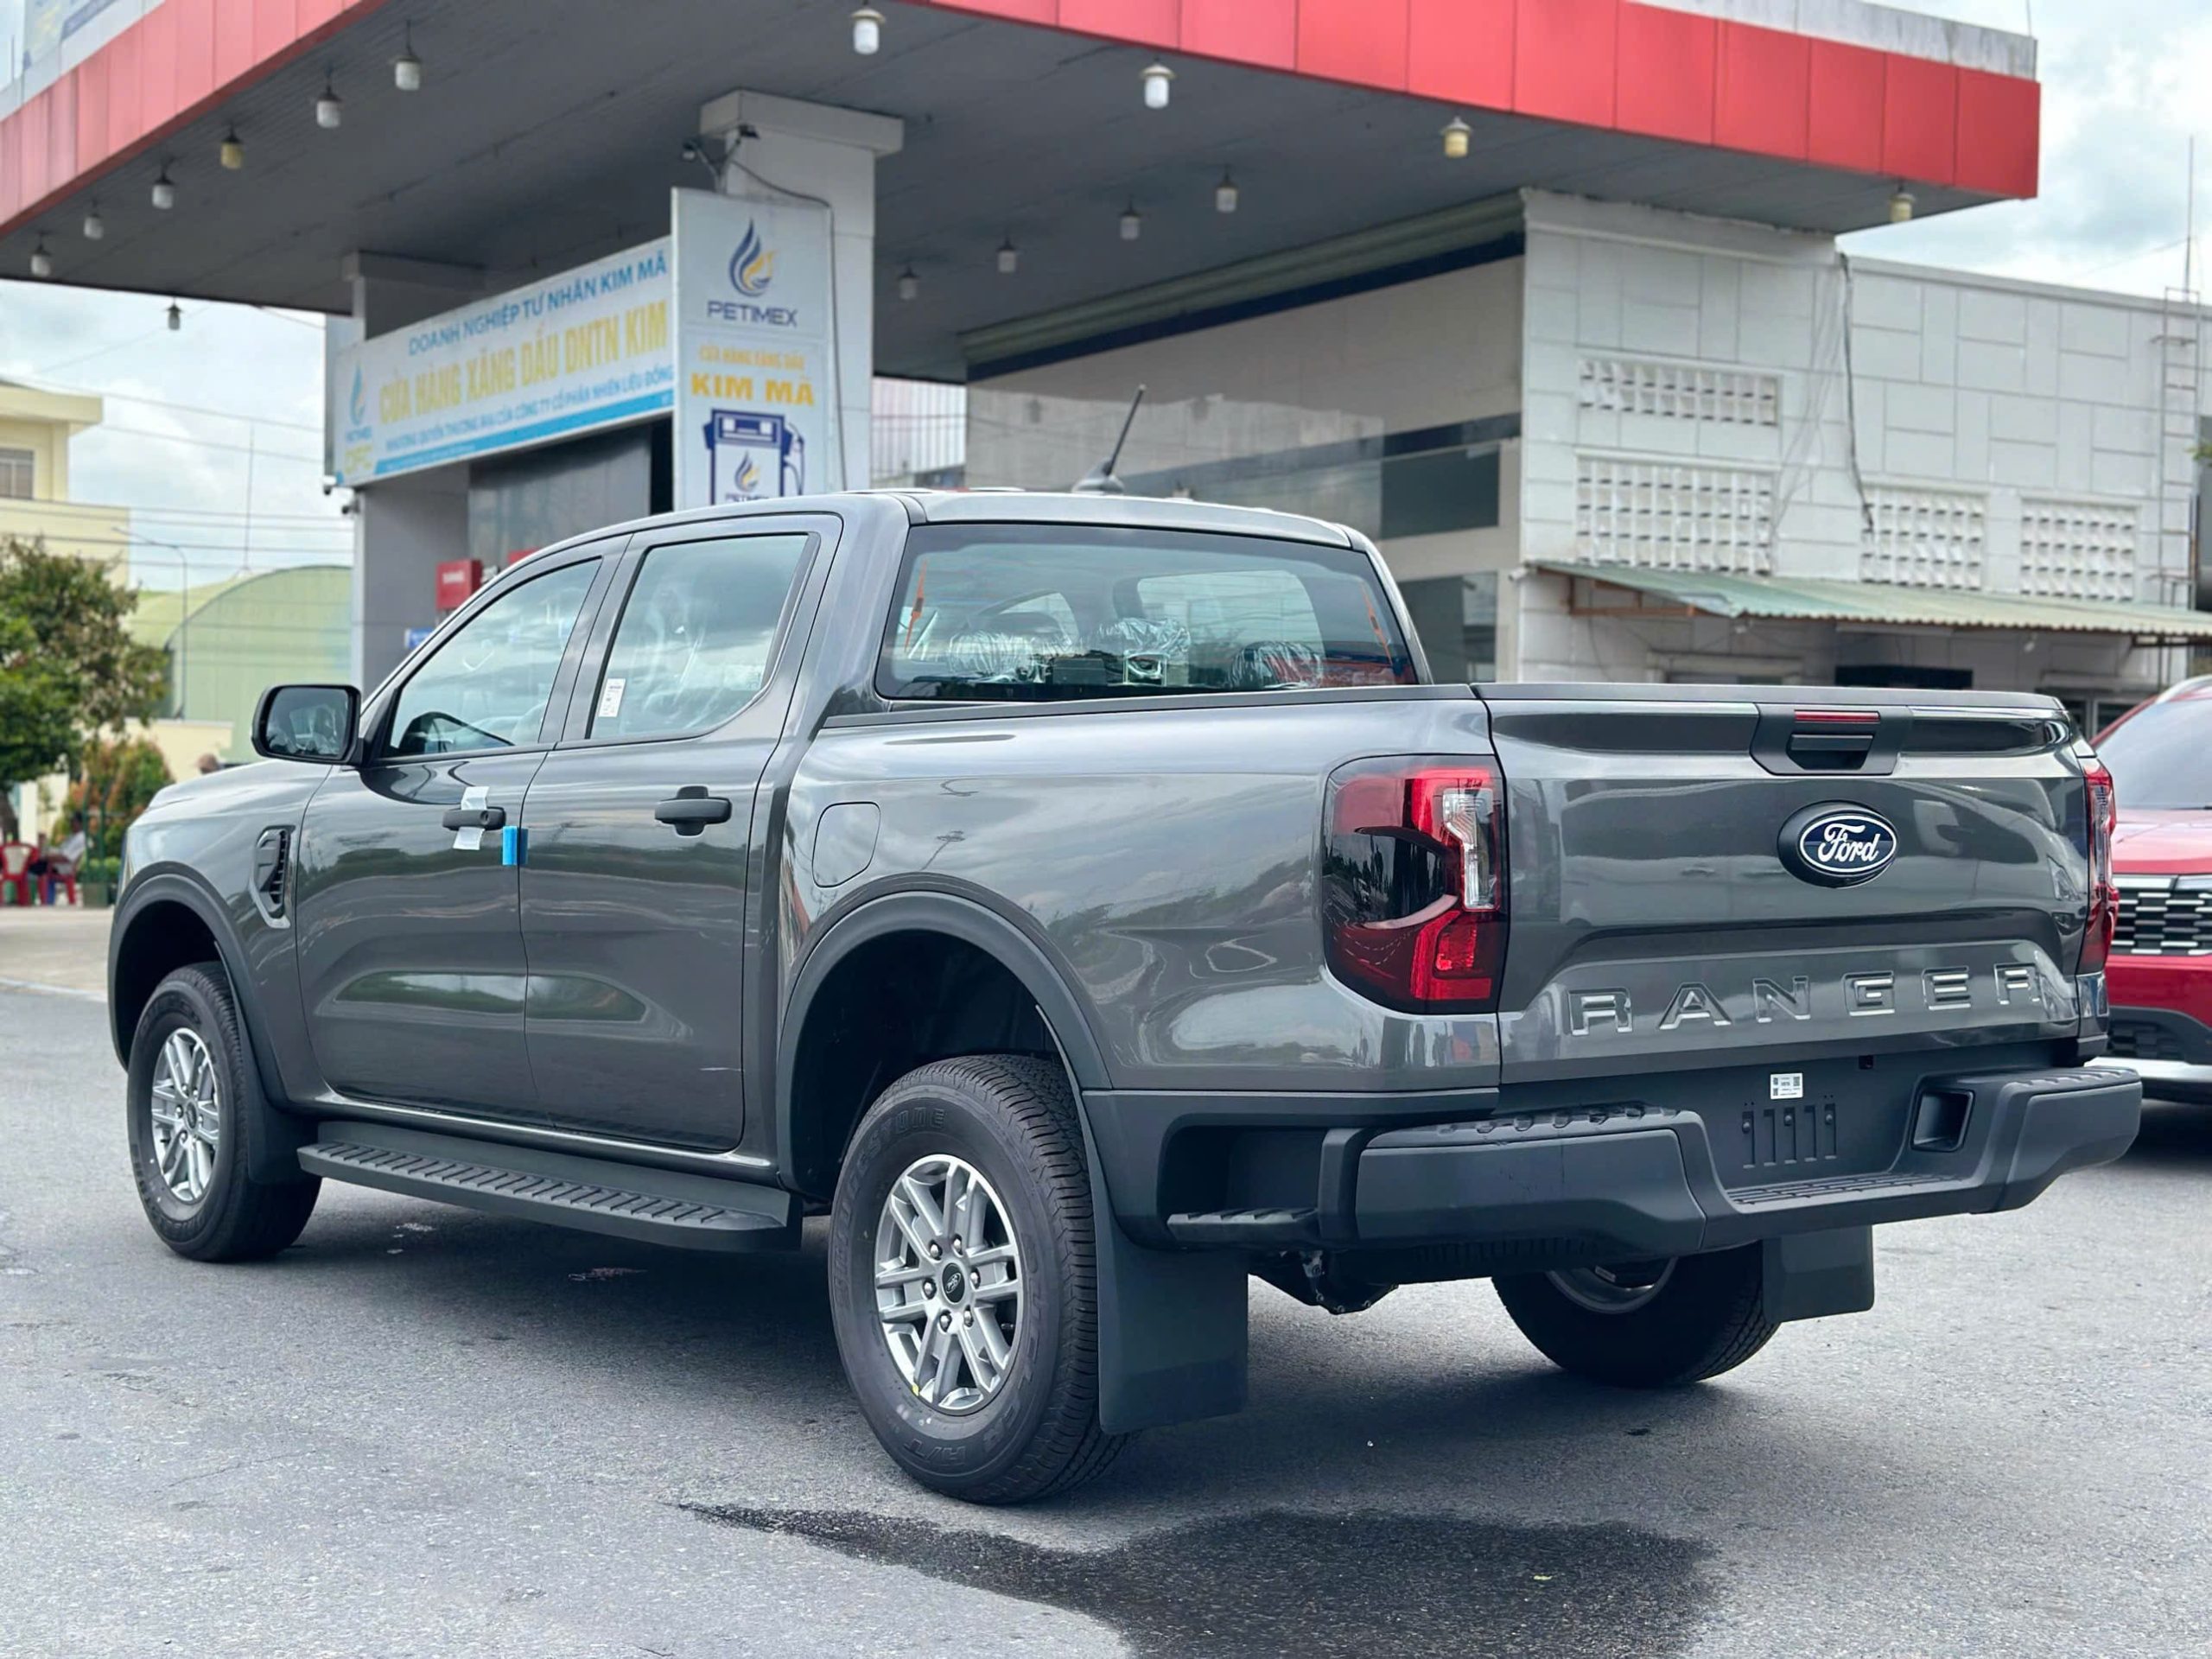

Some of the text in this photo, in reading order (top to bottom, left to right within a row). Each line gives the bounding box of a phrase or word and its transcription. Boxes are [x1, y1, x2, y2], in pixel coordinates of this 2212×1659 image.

[409, 323, 461, 356] DOANH
[601, 264, 632, 294] KIM
[565, 315, 620, 375] DNTN
[626, 300, 668, 359] KIM
[707, 300, 798, 327] PETIMEX
[691, 372, 753, 401] KIM
[1818, 823, 1880, 861] Ford
[1566, 963, 2042, 1037] RANGER
